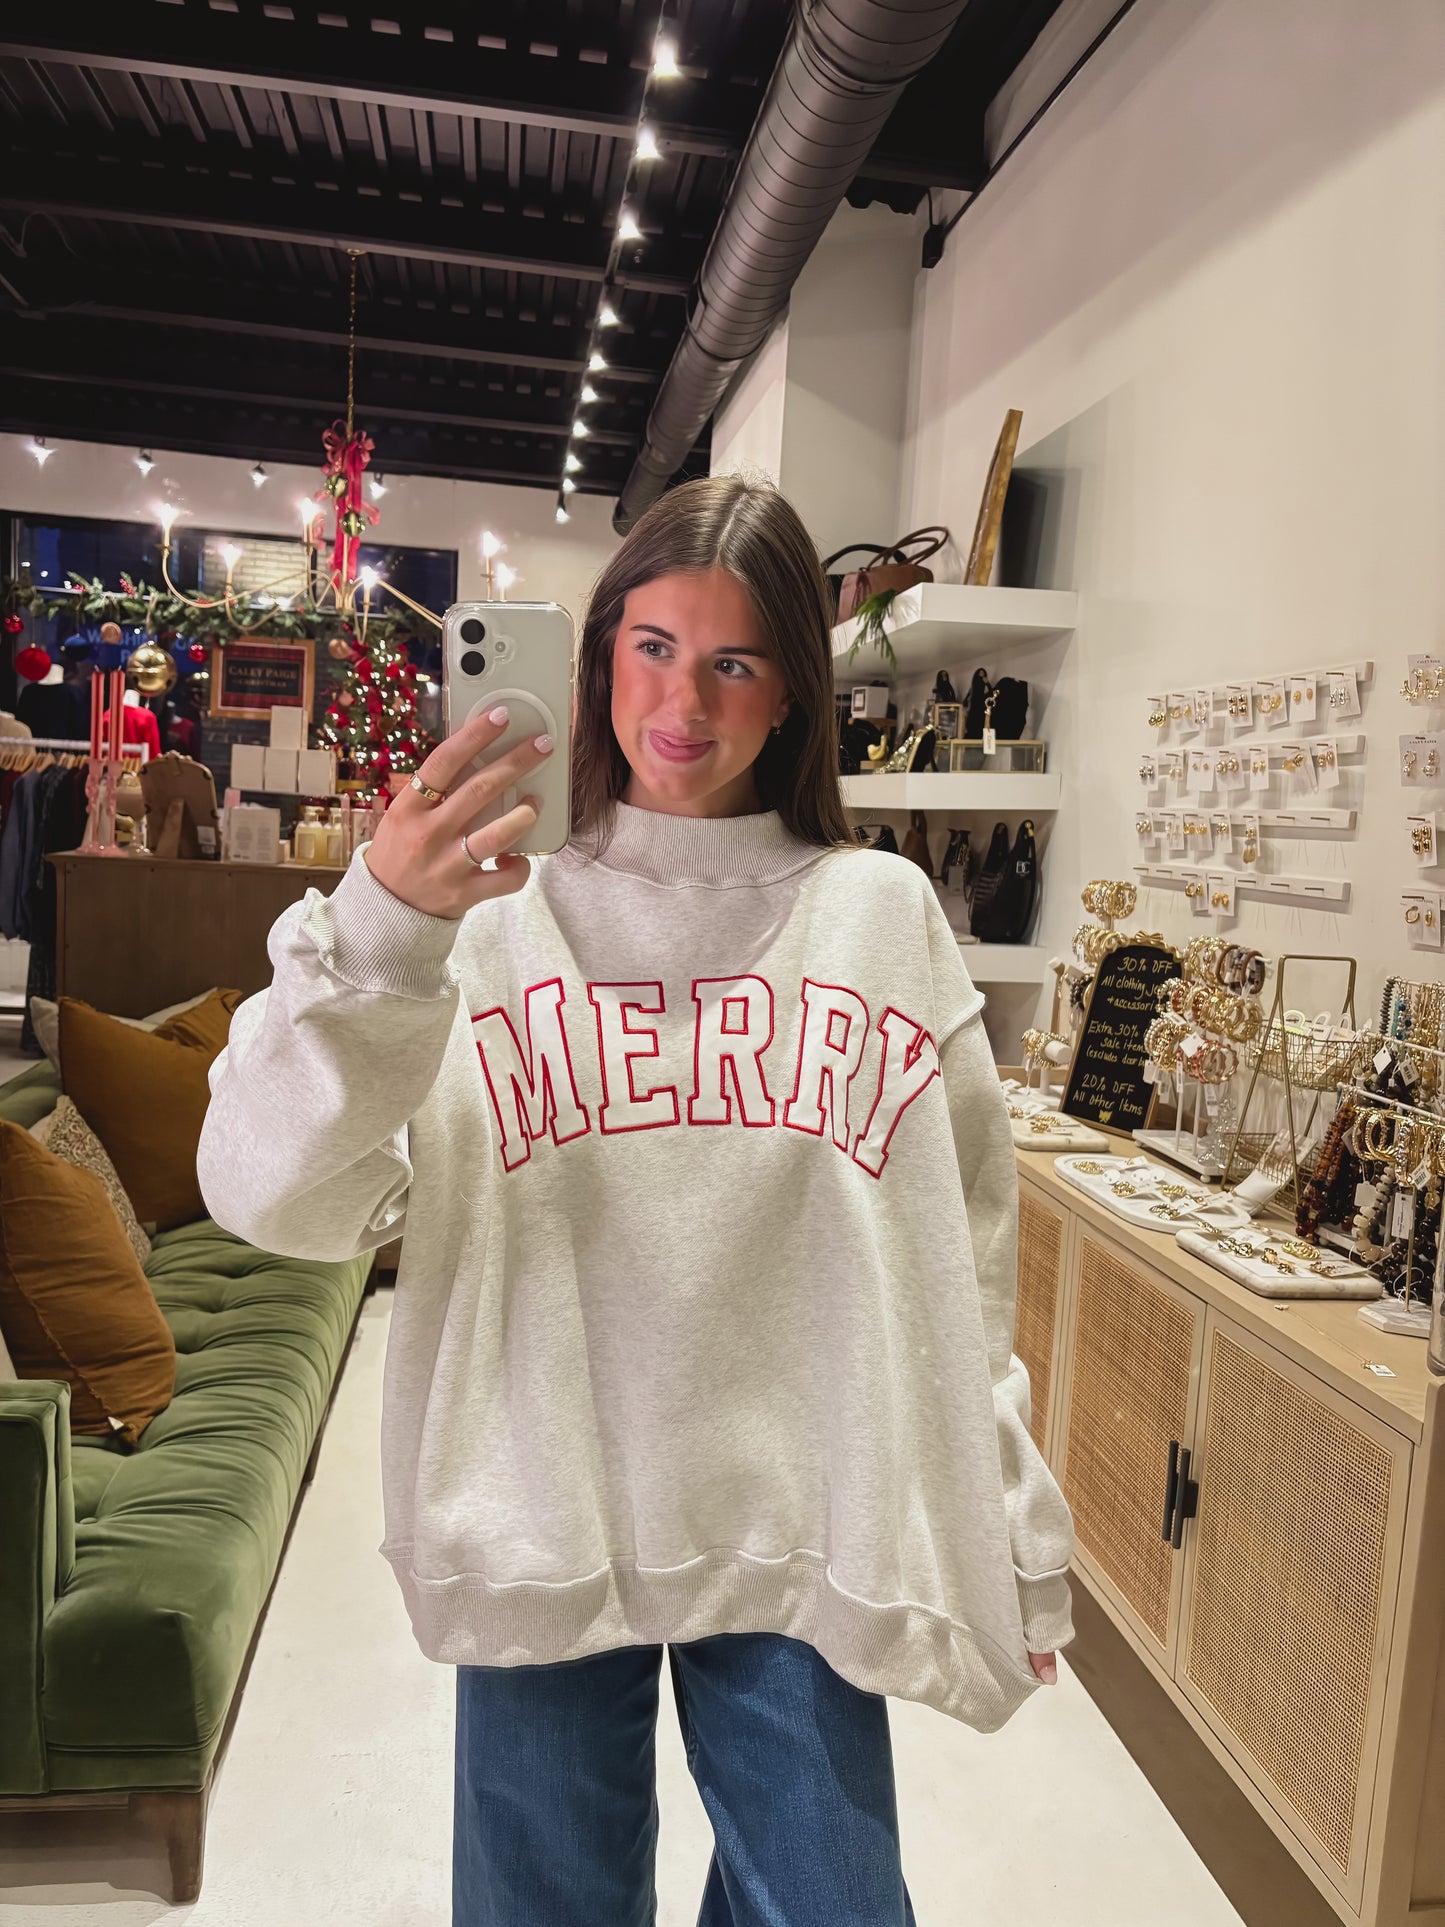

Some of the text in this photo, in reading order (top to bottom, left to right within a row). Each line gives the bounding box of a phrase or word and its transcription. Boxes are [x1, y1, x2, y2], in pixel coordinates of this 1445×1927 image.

[1117, 957, 1173, 974] 30% OFF
[1101, 974, 1115, 987] All
[1115, 975, 1145, 1000] clothing
[1088, 1020, 1113, 1036] Extra
[1114, 1024, 1139, 1039] 30%
[471, 973, 942, 1179] MERRY
[1081, 1073, 1136, 1095] 20% OFF
[1072, 1089, 1086, 1102] All
